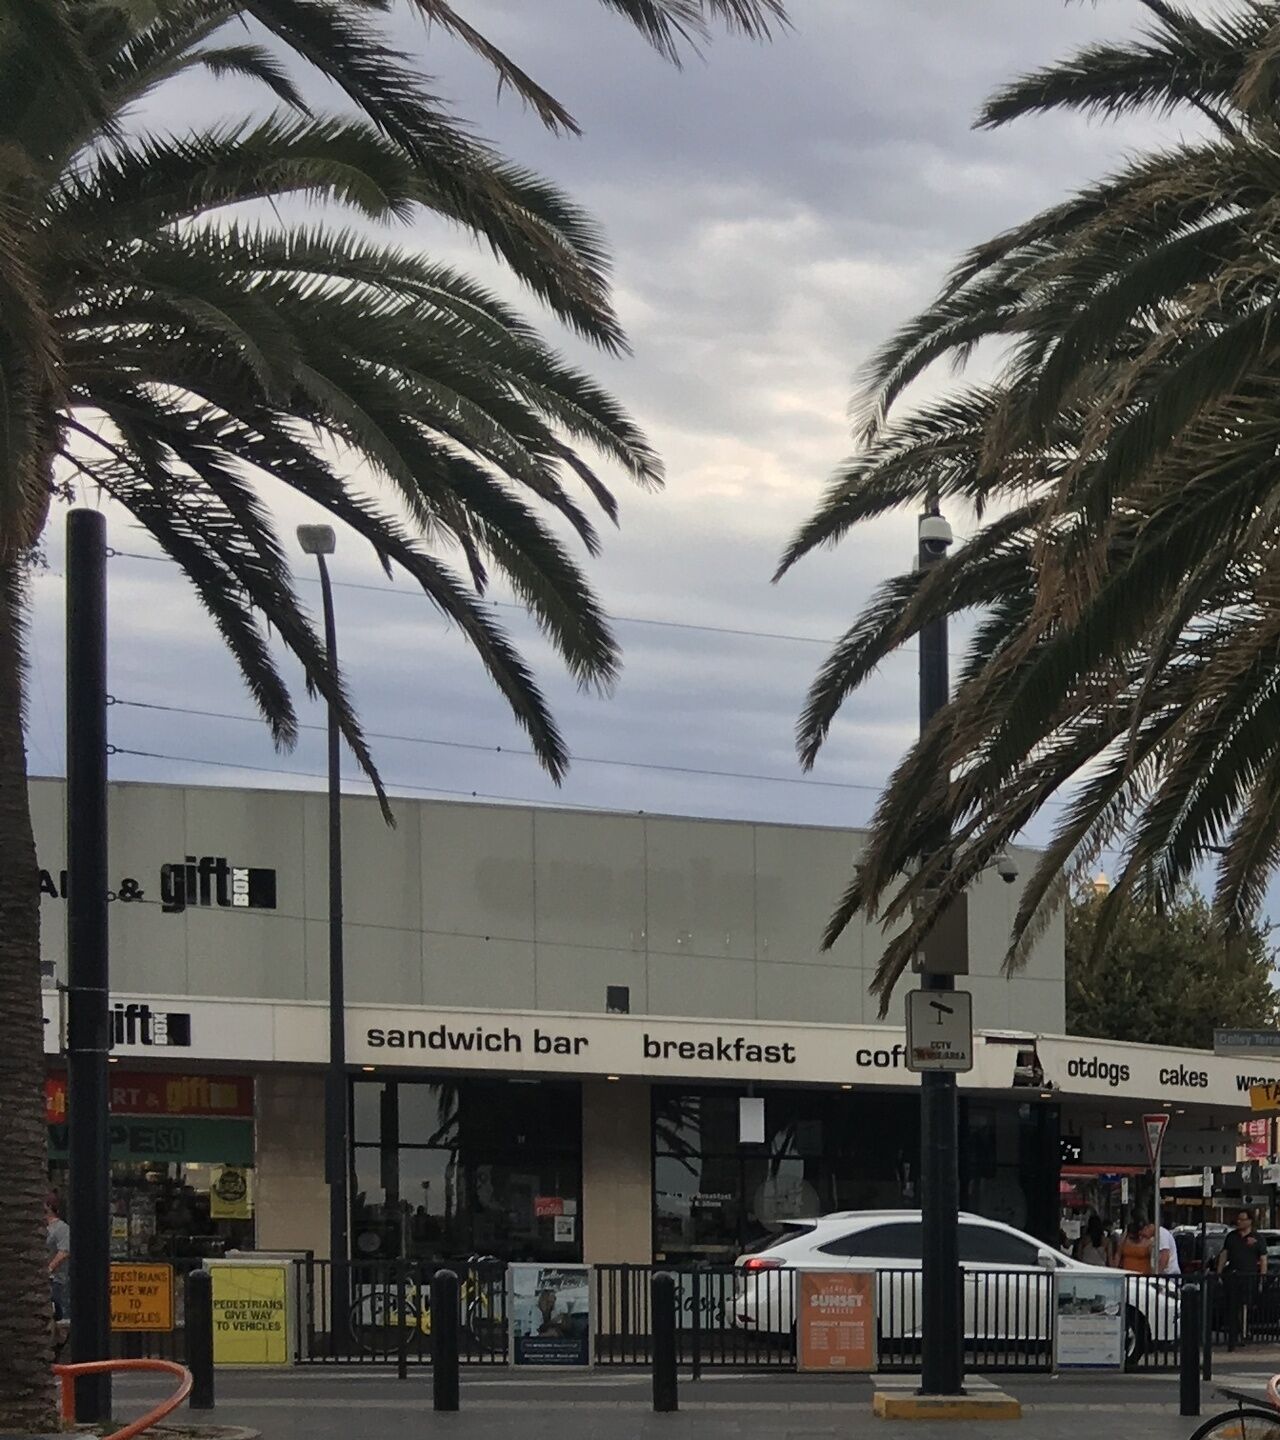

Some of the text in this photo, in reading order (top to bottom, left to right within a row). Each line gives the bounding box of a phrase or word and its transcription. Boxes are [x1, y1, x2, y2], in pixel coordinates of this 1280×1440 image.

[160, 856, 231, 913] gift
[233, 868, 249, 907] BOX
[367, 1024, 589, 1055] sandwich bar
[930, 1041, 952, 1050] CCTV
[643, 1034, 796, 1064] breakfast
[1068, 1056, 1130, 1087] otdogs
[1159, 1064, 1208, 1088] cakes
[110, 1270, 168, 1283] EDESTRIANS
[111, 1285, 160, 1297] GIVE WAY
[129, 1298, 142, 1309] TO
[213, 1299, 283, 1310] PEDESTRIANS
[810, 1294, 864, 1308] SUNSET
[110, 1311, 161, 1324] VEHICLES
[224, 1310, 273, 1320] GIVE WAY
[216, 1321, 282, 1332] TO VEHICLES
